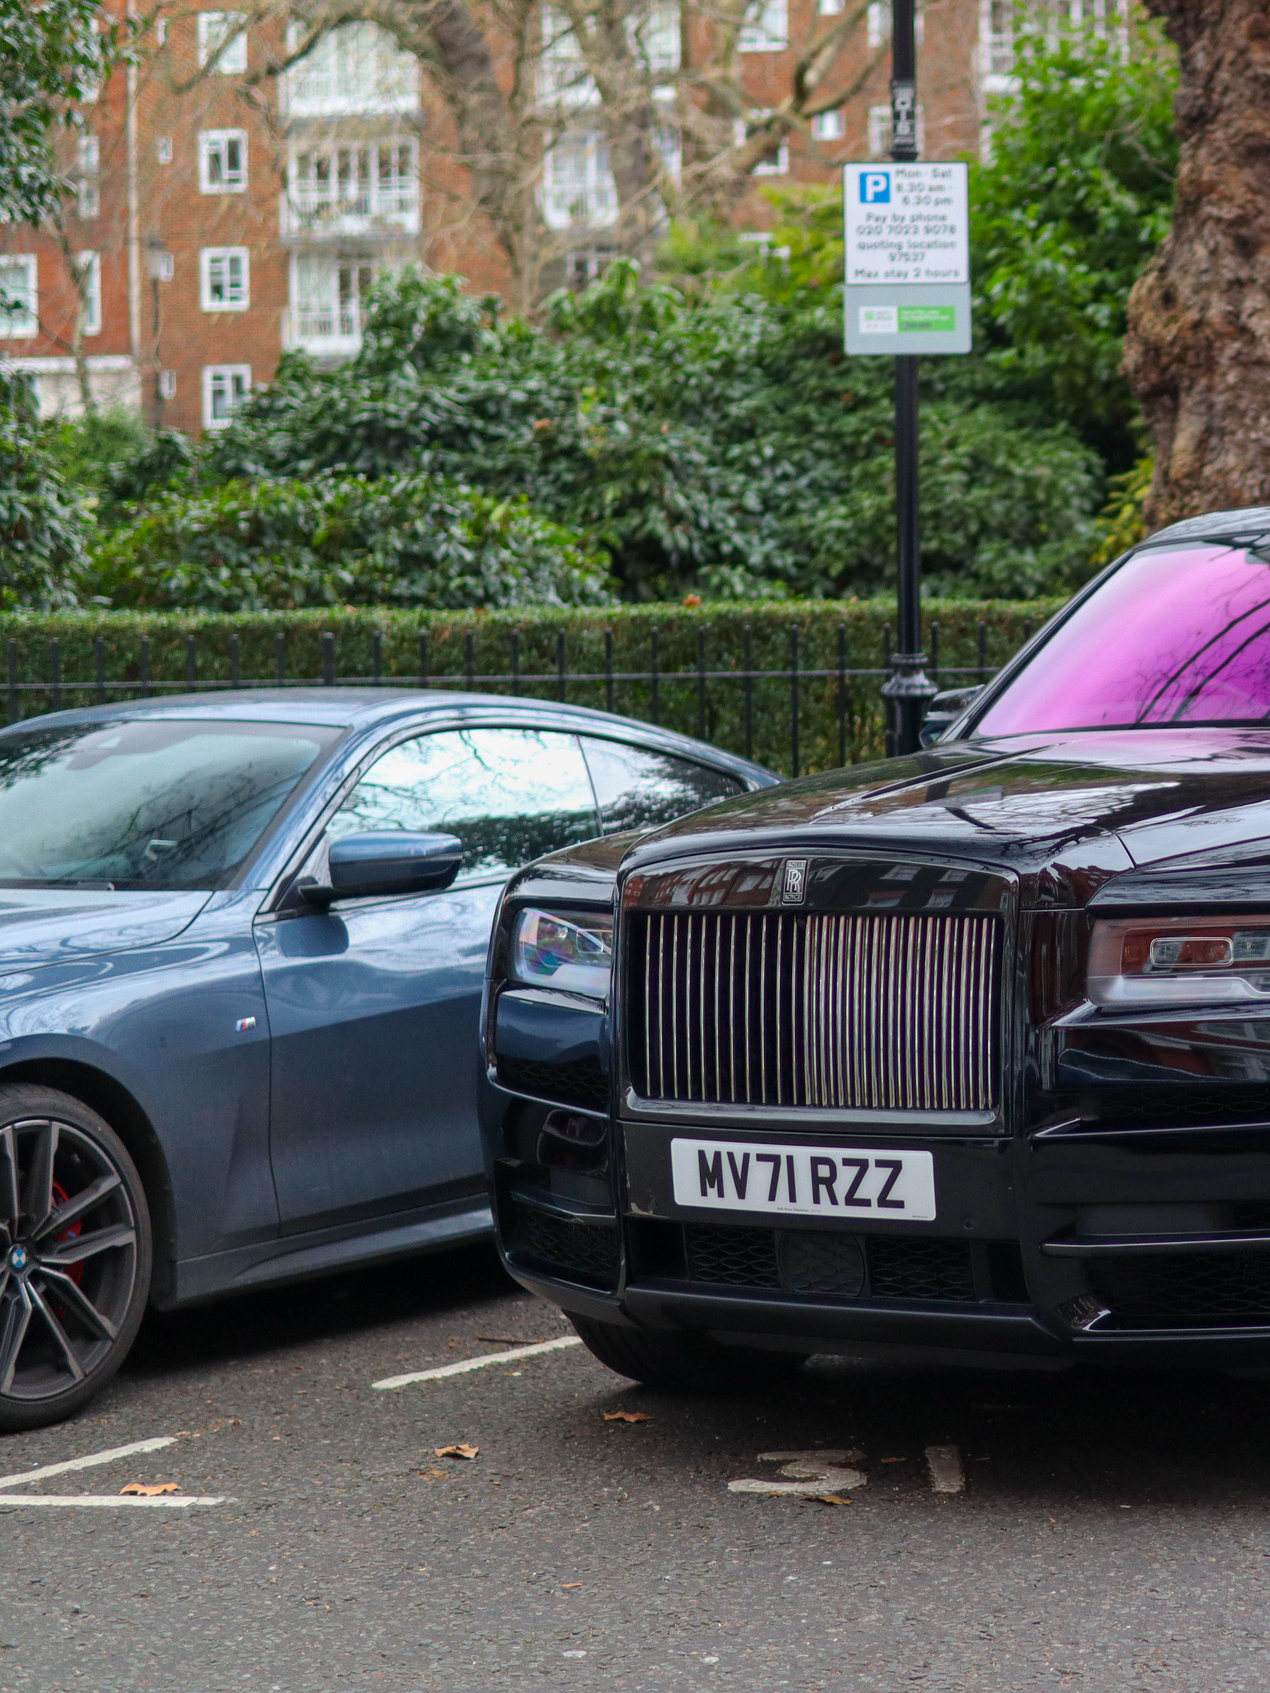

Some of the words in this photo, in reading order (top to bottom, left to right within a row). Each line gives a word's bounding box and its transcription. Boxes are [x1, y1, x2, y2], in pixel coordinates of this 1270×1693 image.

[895, 168, 922, 178] Mon
[931, 168, 953, 178] Sat
[866, 174, 888, 202] P
[928, 185, 946, 193] am
[934, 198, 954, 207] pm
[866, 212, 888, 224] Pay
[891, 212, 906, 224] by
[910, 212, 947, 223] phone
[856, 225, 884, 236] 020
[856, 240, 904, 251] quoting
[907, 240, 958, 250] location
[854, 268, 880, 278] Max
[884, 268, 910, 279] stay
[913, 267, 922, 278] 2
[925, 267, 960, 278] hours
[698, 1149, 798, 1204] MV71
[810, 1156, 905, 1210] RZZ
